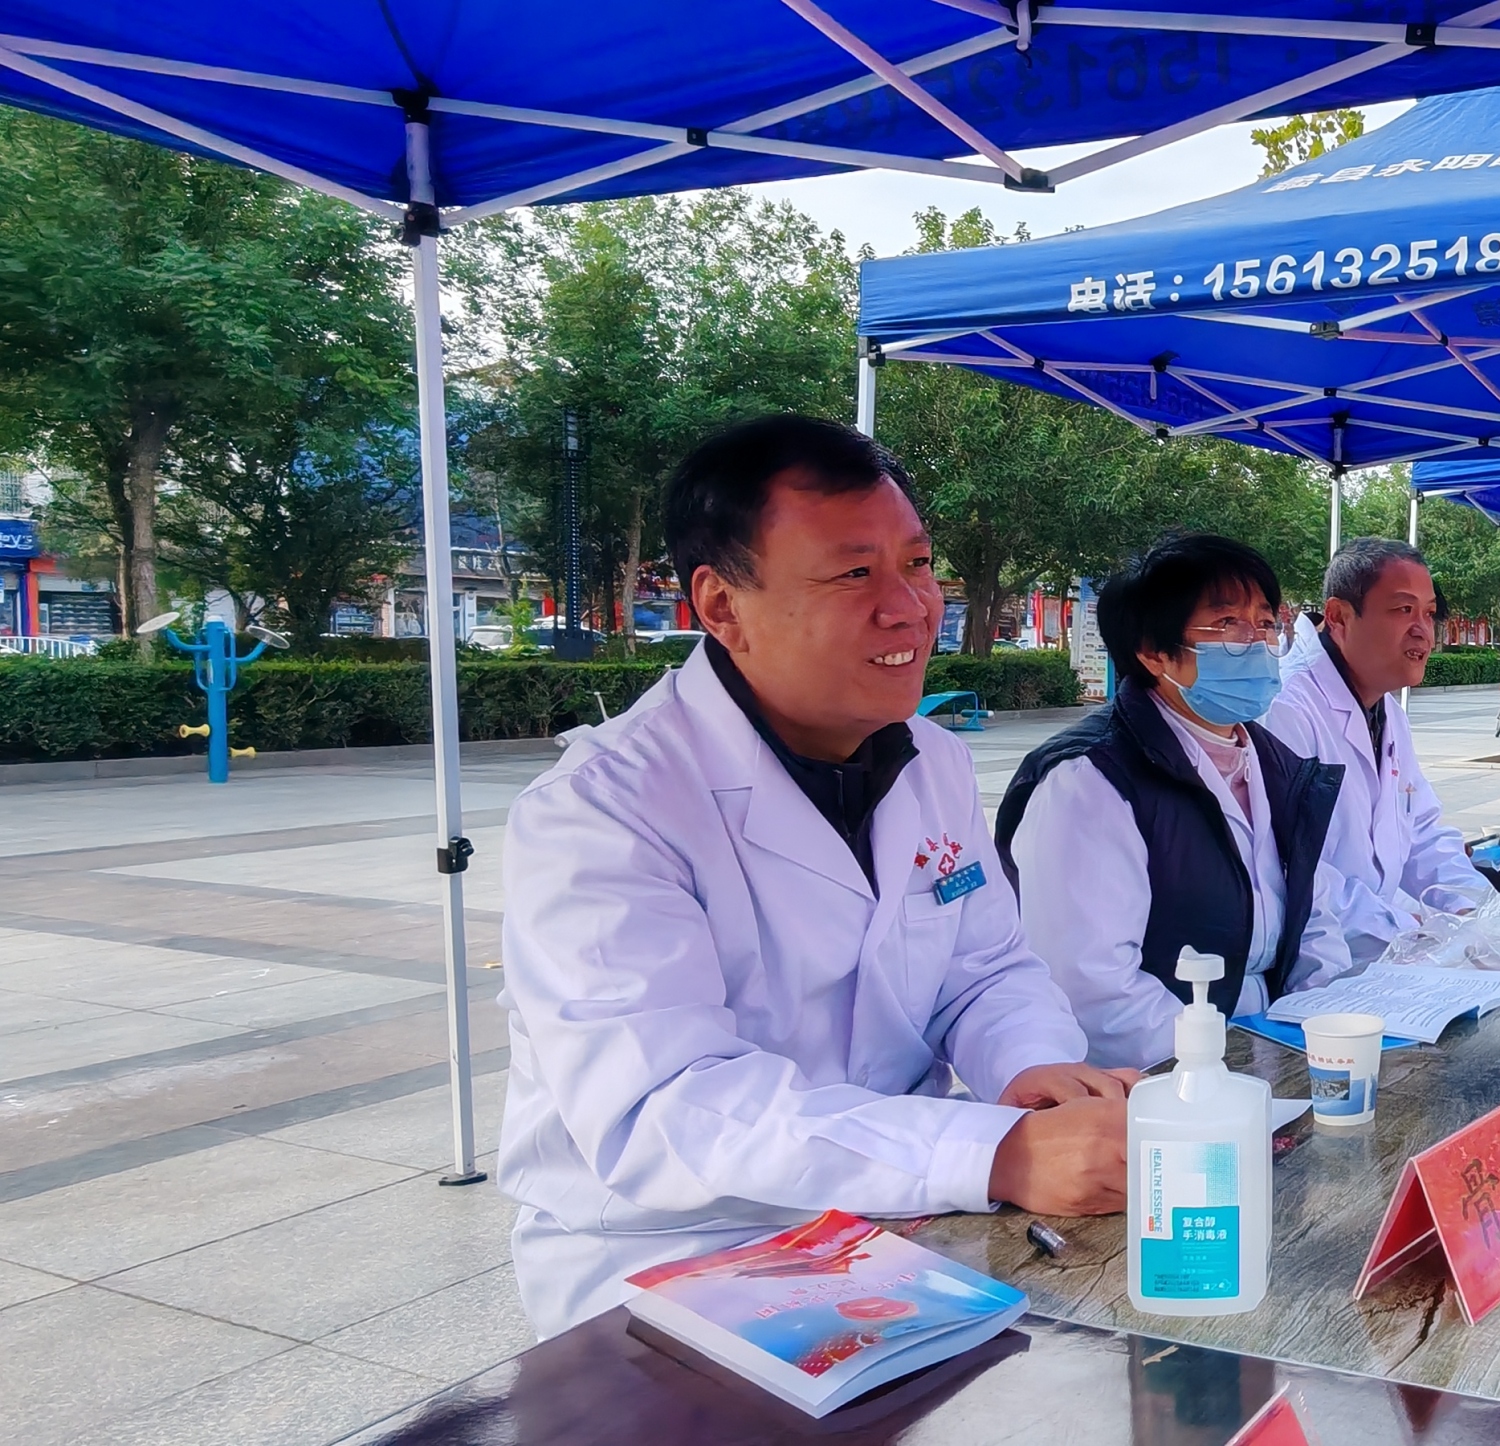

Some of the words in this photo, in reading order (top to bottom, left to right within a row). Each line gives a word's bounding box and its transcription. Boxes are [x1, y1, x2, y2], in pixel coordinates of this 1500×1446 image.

[1153, 1148, 1163, 1187] HEALTH
[1153, 1189, 1163, 1233] ESSENCE
[1183, 1229, 1227, 1241] 手消毒液
